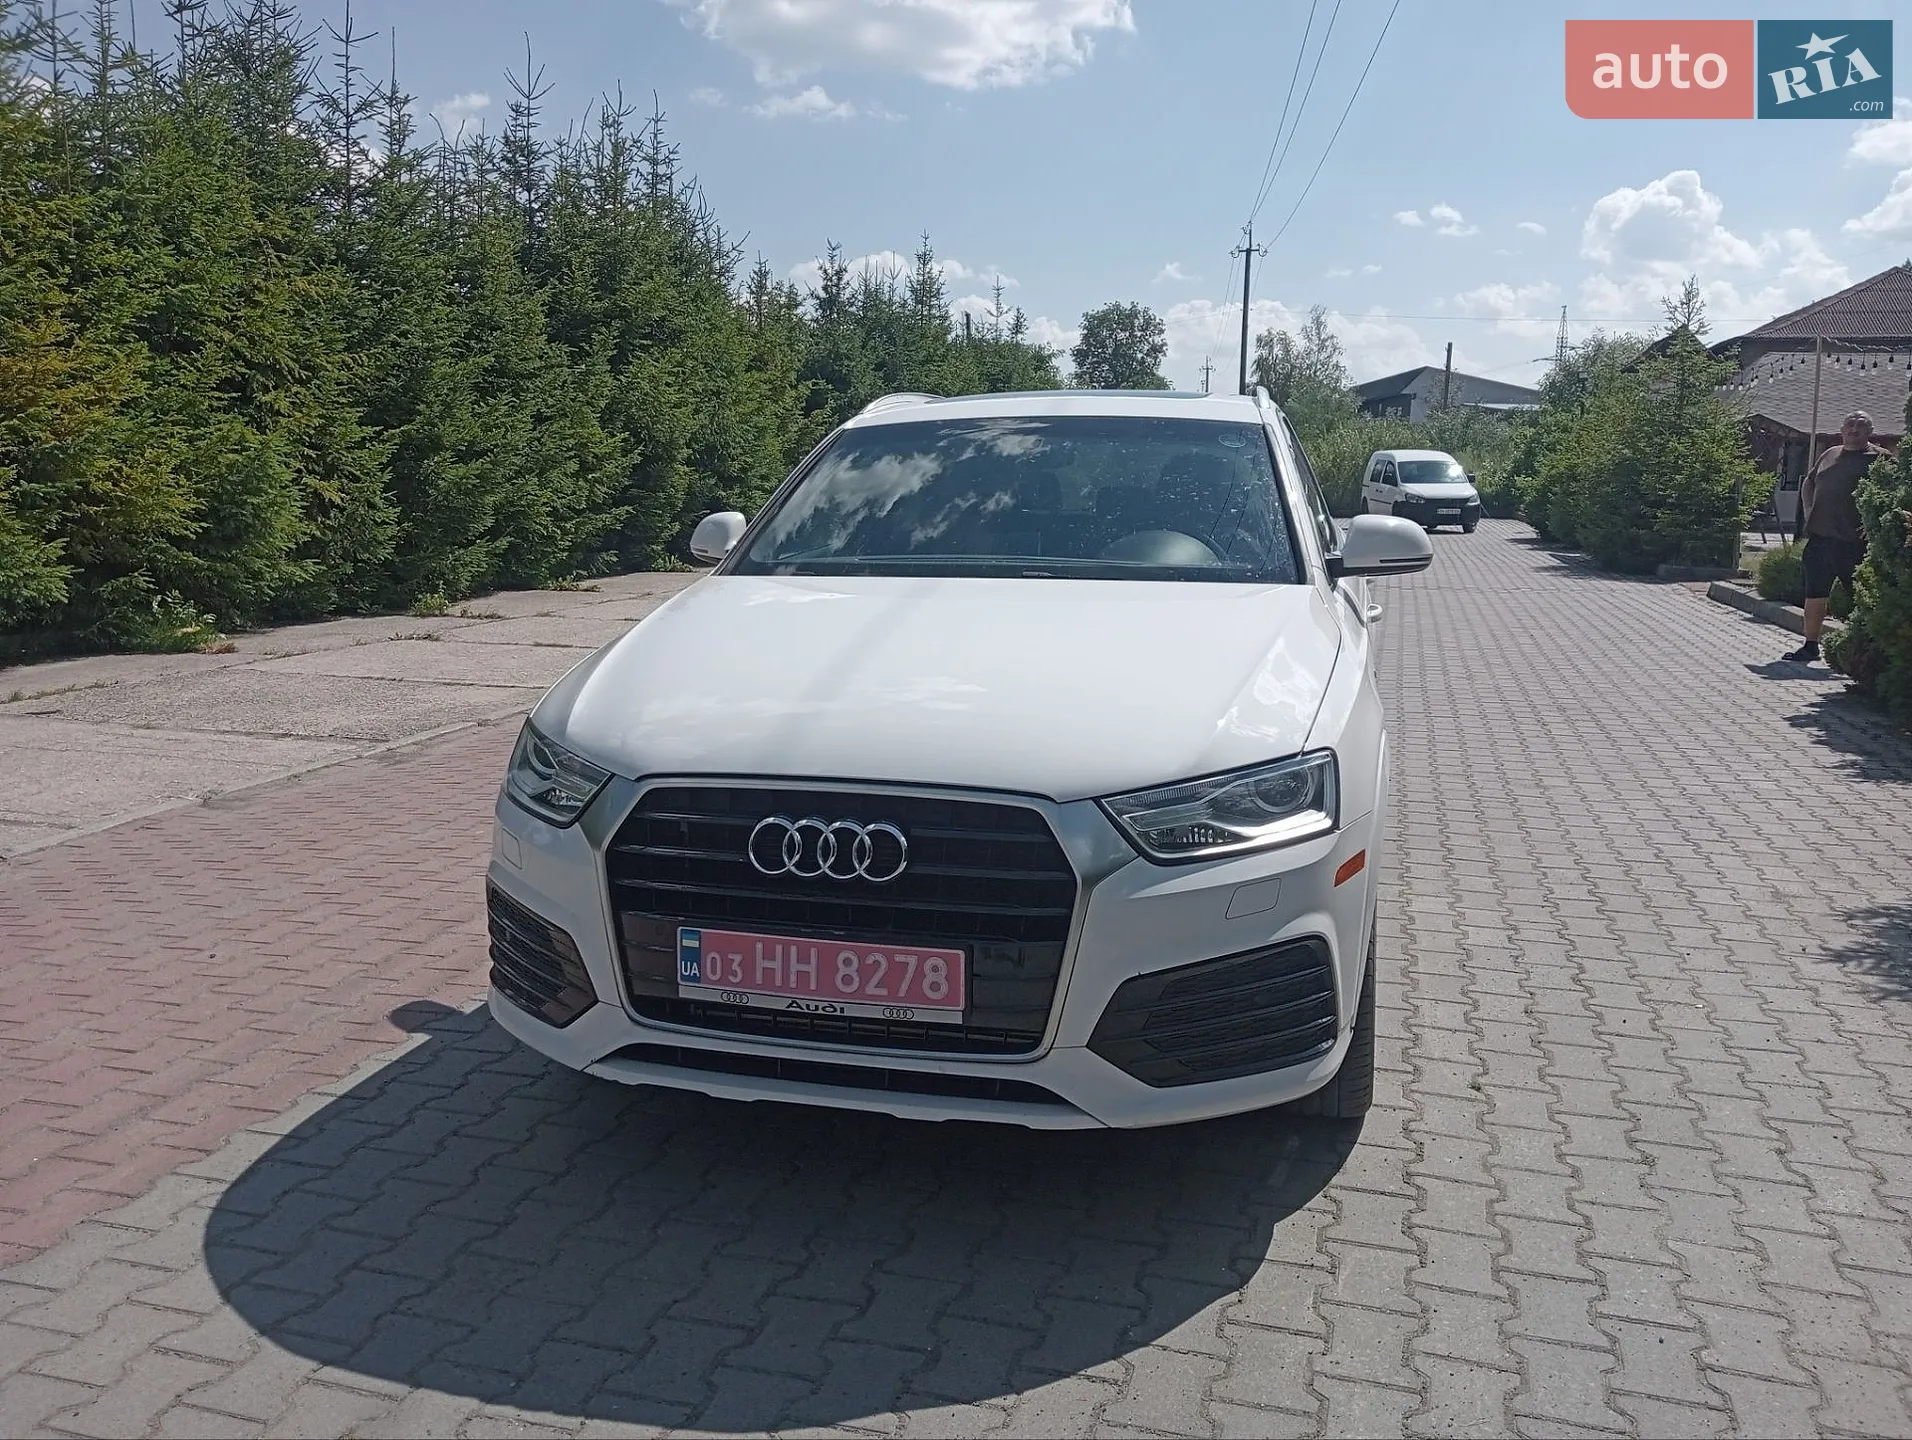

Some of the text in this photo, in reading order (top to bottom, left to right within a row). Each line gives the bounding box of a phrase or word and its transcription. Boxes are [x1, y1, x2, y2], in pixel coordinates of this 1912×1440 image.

[681, 960, 700, 977] UA
[706, 942, 948, 999] 03 HH 8278
[785, 1000, 845, 1014] Audi
